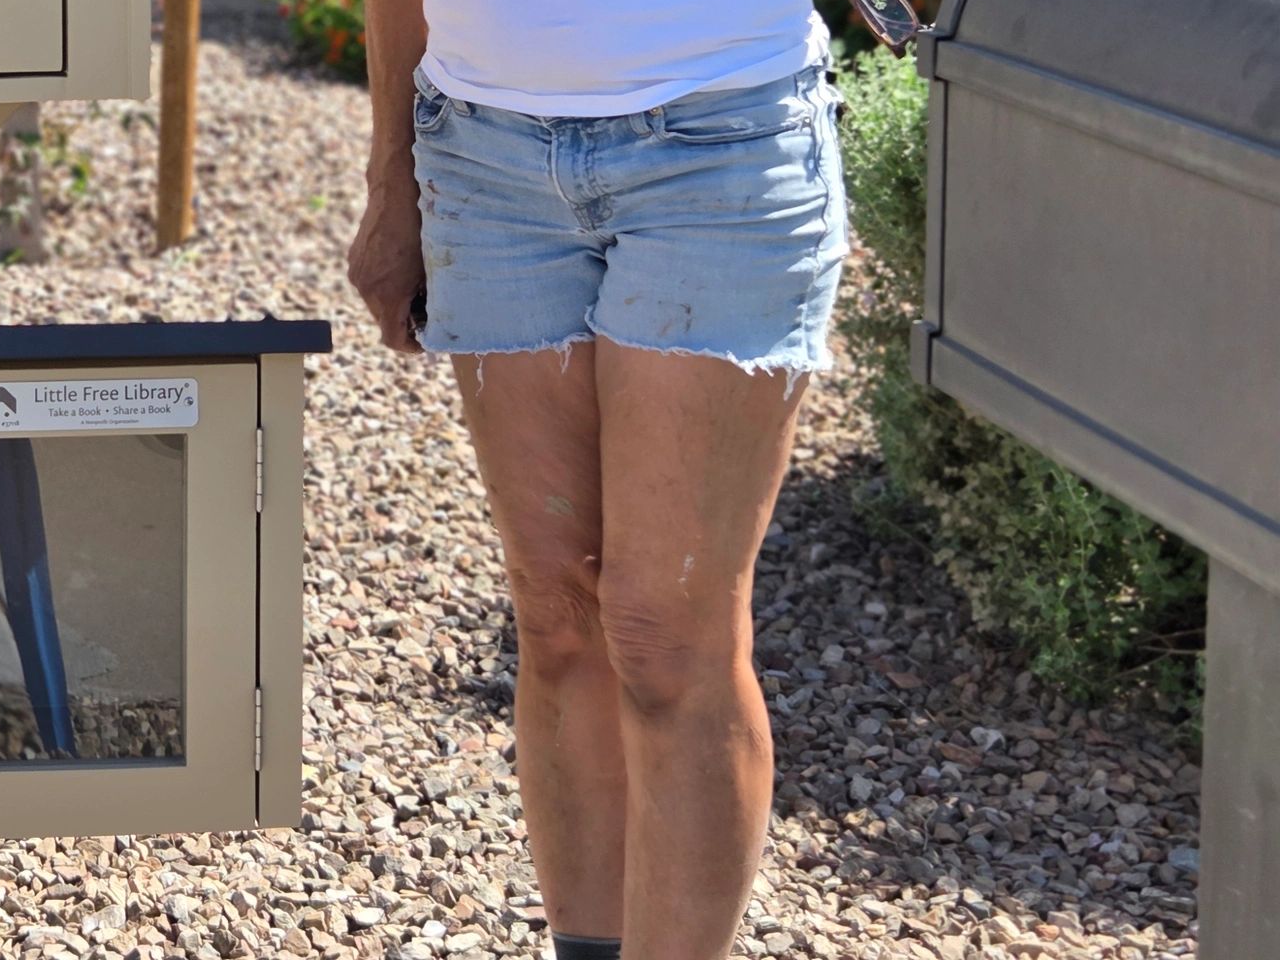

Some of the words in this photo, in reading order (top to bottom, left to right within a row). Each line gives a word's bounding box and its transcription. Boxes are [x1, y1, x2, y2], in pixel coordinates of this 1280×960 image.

[34, 385, 78, 403] Little
[83, 386, 119, 401] Free
[124, 383, 184, 404] Library
[48, 407, 69, 417] Take
[79, 406, 101, 416] Book
[113, 406, 139, 415] Share
[148, 404, 171, 414] Book
